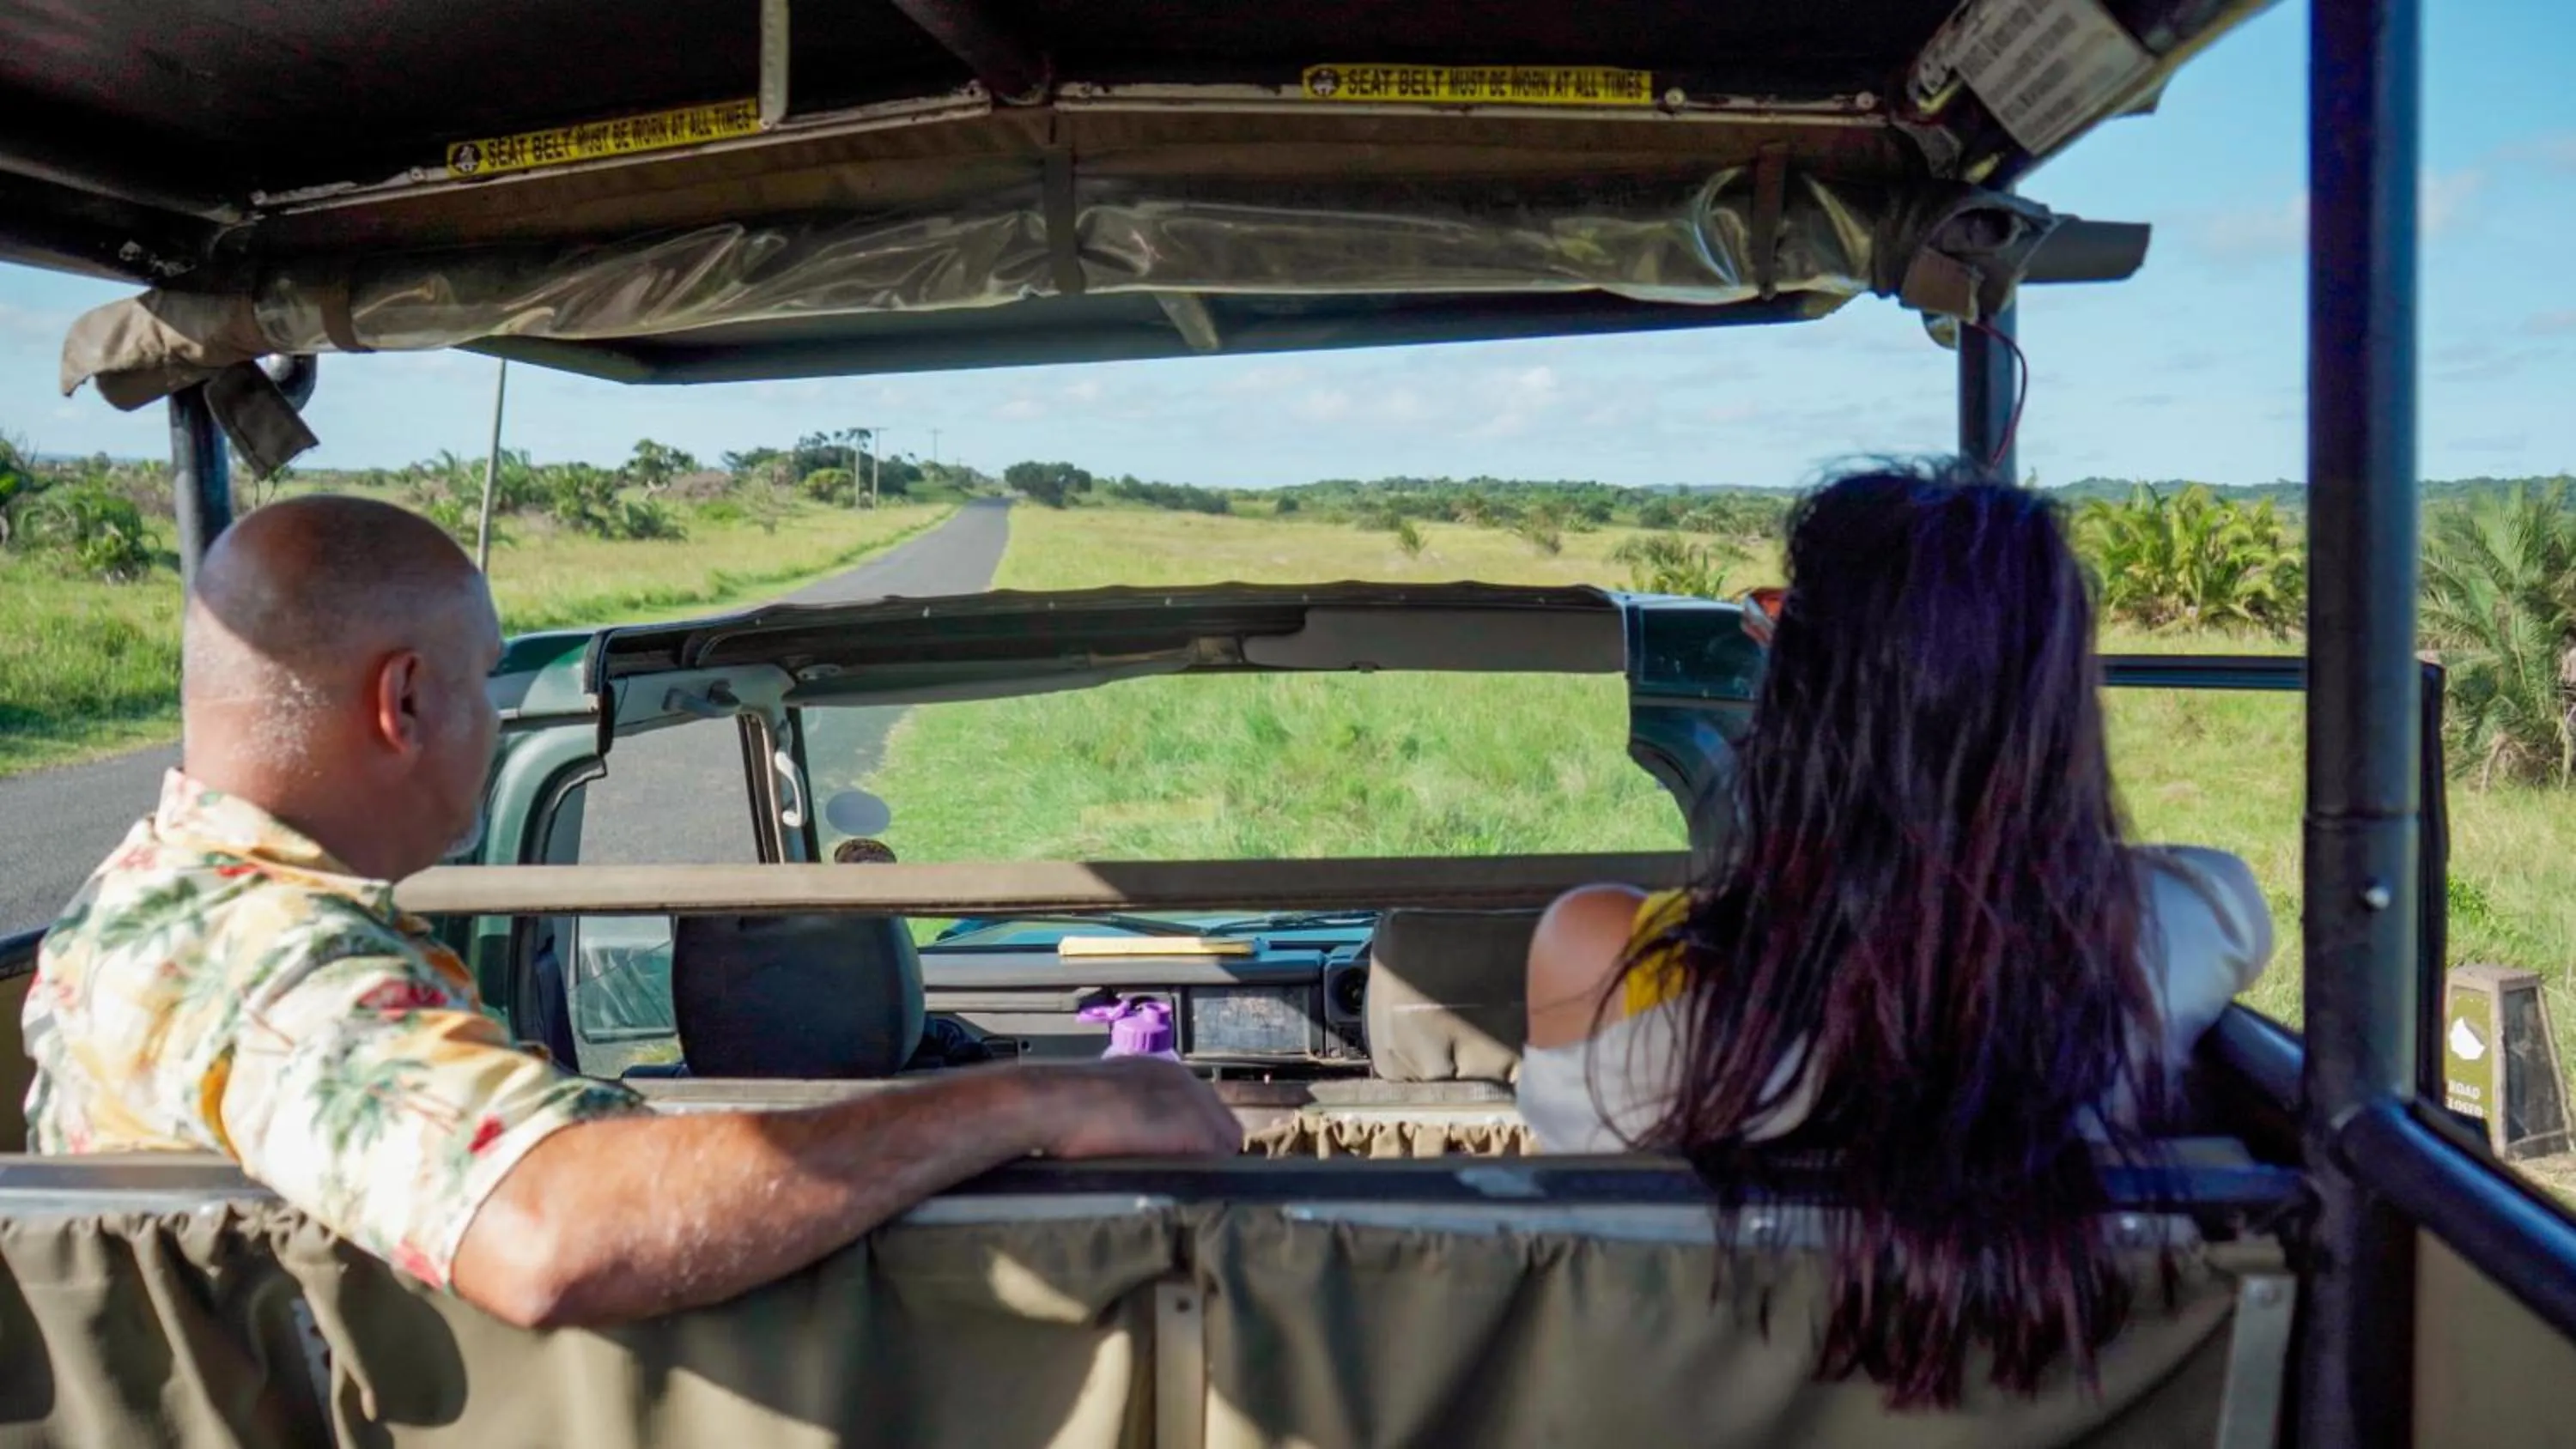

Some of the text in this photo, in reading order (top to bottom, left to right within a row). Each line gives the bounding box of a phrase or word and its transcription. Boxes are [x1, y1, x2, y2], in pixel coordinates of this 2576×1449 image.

[1347, 69, 1642, 98] SEAT BELT MUST BE WORN AT ALL TIMES
[487, 137, 526, 167] SEAT
[533, 130, 572, 161] BELT
[613, 121, 630, 149] BE
[633, 117, 665, 146] WORN
[671, 112, 686, 141] AT
[690, 109, 712, 137] ALL
[714, 104, 751, 134] TIMES
